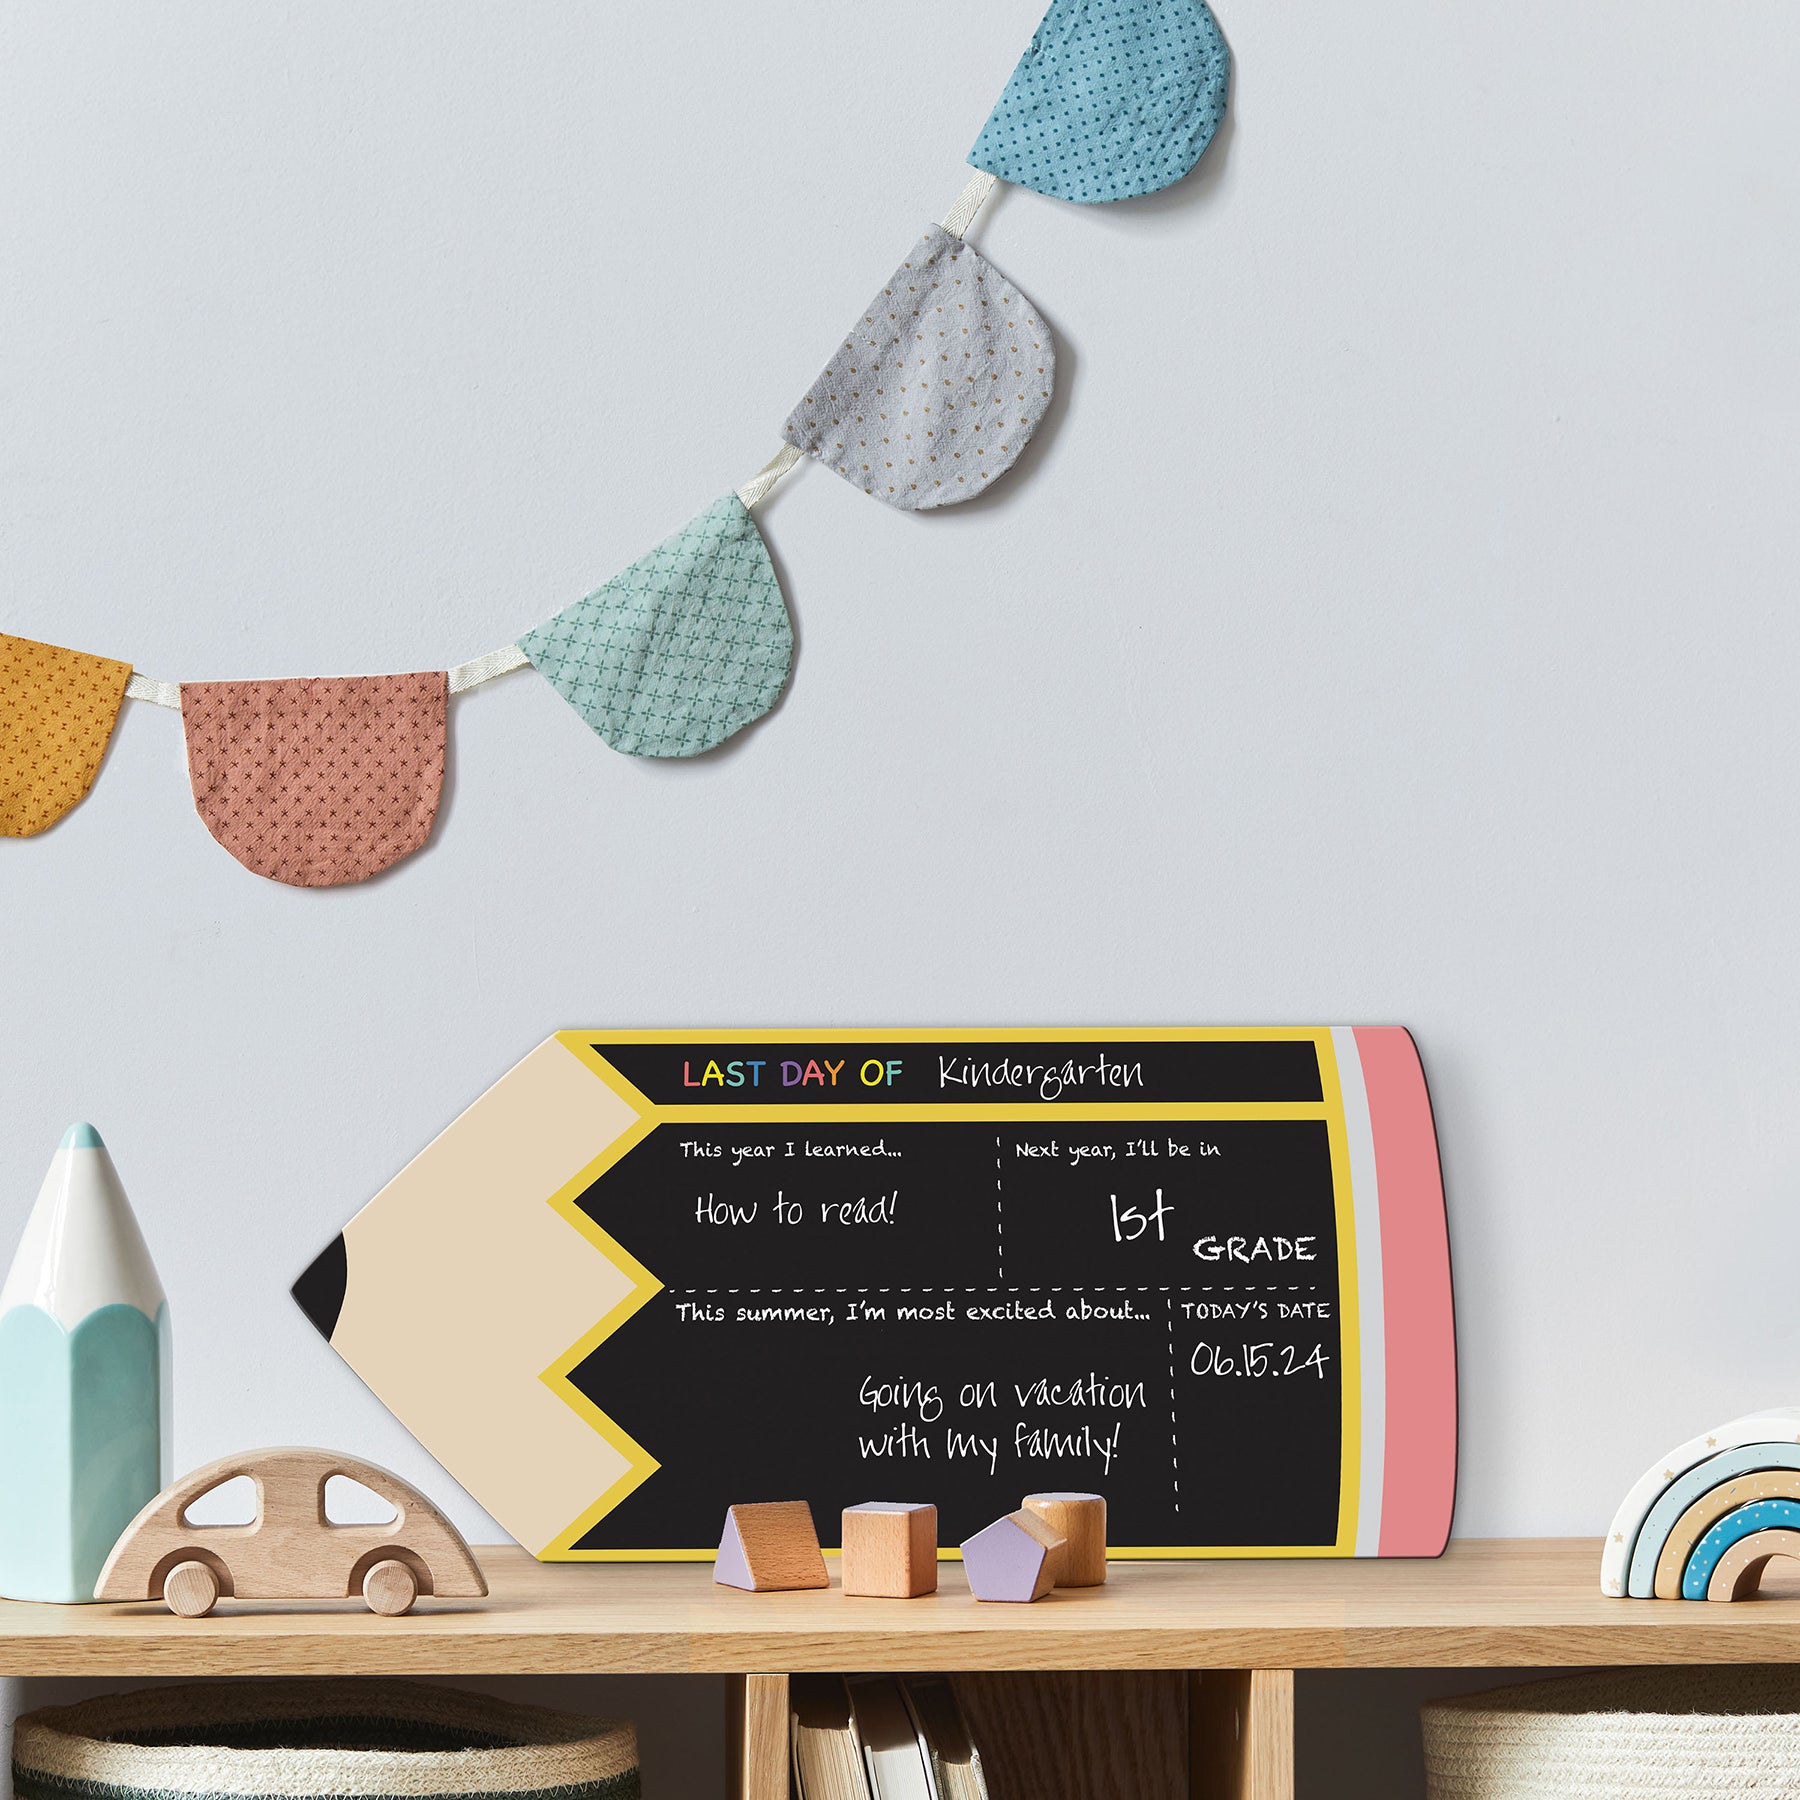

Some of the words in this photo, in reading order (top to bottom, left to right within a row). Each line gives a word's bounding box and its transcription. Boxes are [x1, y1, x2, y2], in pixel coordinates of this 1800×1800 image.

[683, 1059, 767, 1087] LAST
[779, 1058, 846, 1087] DAY
[859, 1058, 903, 1087] OF
[938, 1052, 1144, 1100] Kindergarten
[679, 1140, 723, 1158] This
[731, 1145, 776, 1167] year
[1015, 1140, 1060, 1158] Next
[1068, 1145, 1116, 1167] year,
[1167, 1137, 1192, 1158] be
[1199, 1141, 1222, 1157] in
[694, 1192, 758, 1226] How
[772, 1190, 803, 1225] to
[821, 1190, 898, 1226] read!
[1192, 1234, 1318, 1264] GRADE
[675, 1302, 725, 1322] This
[736, 1307, 835, 1326] summer,
[896, 1300, 956, 1321] most
[966, 1298, 1057, 1321] excited
[1180, 1299, 1269, 1320] TODAY'S
[1276, 1301, 1331, 1319] DATE
[1190, 1341, 1330, 1380] 06.15.24
[859, 1375, 944, 1423] Going
[959, 1381, 998, 1409] on
[1014, 1371, 1147, 1409] vacation
[858, 1422, 931, 1459] with
[947, 1427, 998, 1476] my
[1014, 1421, 1121, 1476] family!
